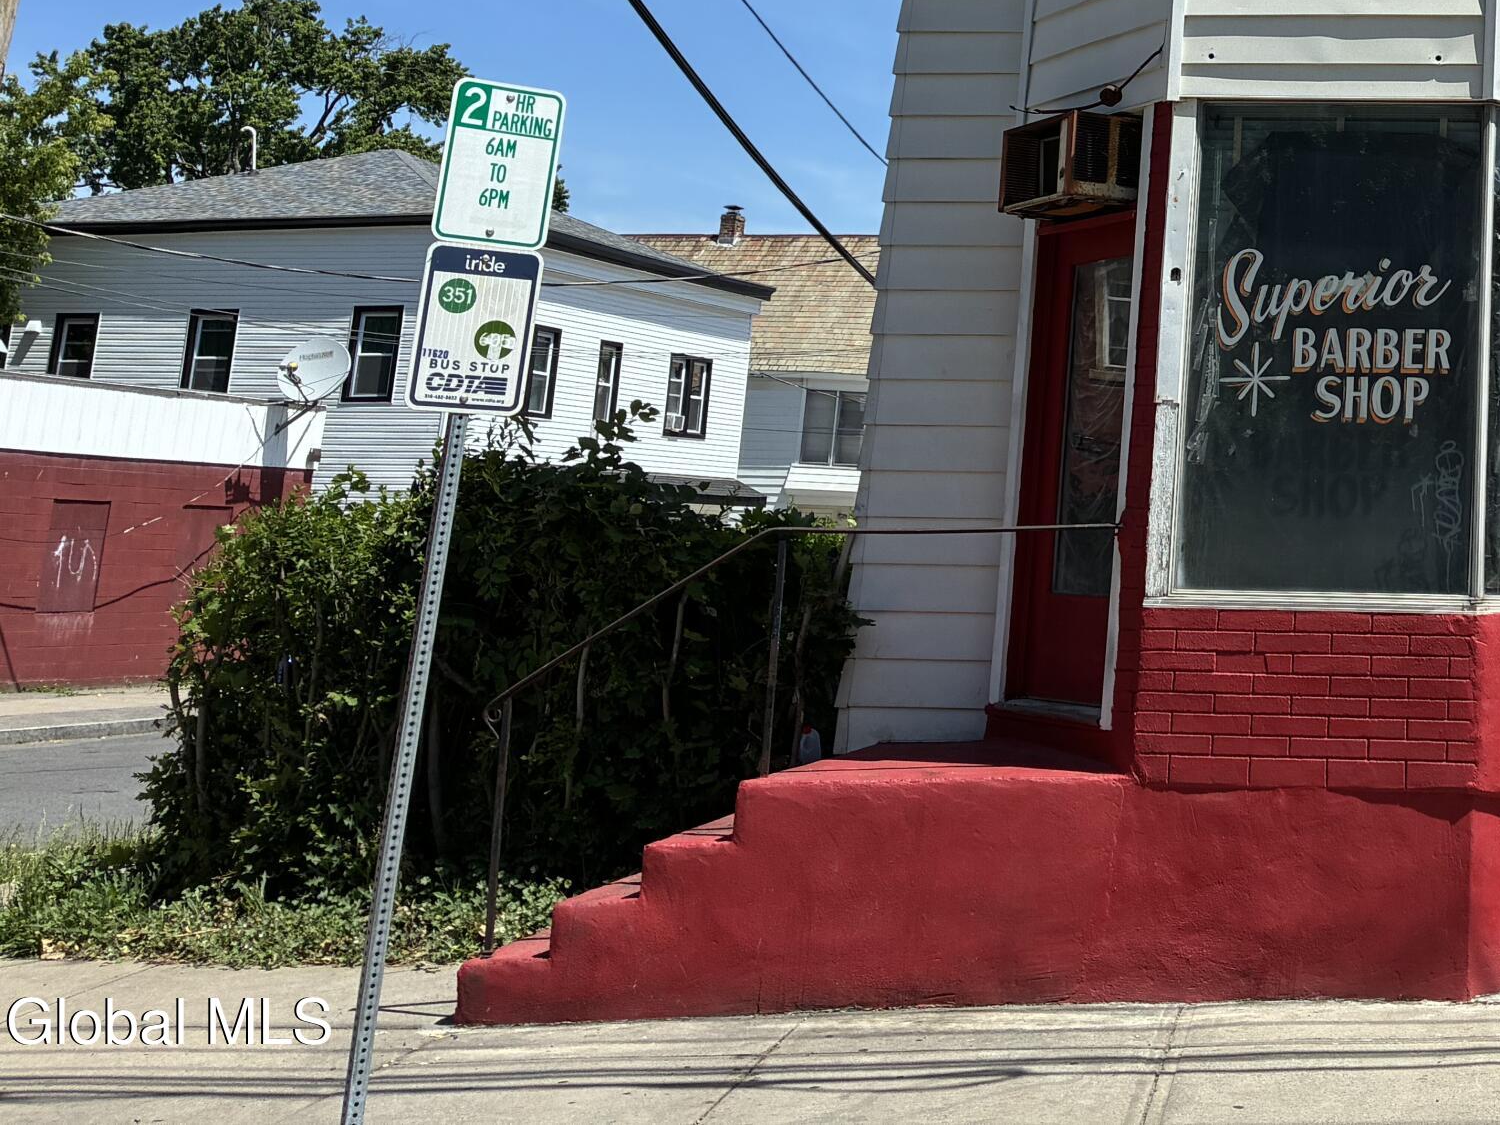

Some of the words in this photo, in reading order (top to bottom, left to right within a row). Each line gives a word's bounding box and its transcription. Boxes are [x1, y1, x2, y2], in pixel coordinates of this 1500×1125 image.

[460, 86, 487, 126] 2
[515, 93, 536, 115] HR
[491, 110, 553, 137] PARKING
[485, 137, 518, 159] 6AM
[490, 162, 507, 184] TO
[478, 188, 510, 210] 6PM
[465, 254, 506, 273] iride
[442, 286, 473, 305] 351
[1217, 248, 1452, 350] Superior
[422, 348, 448, 359] 11620
[1291, 327, 1452, 375] BARBER
[429, 359, 460, 370] BUS
[469, 362, 510, 373] STOP
[425, 372, 508, 395] CDTA
[1310, 375, 1430, 424] SHOP
